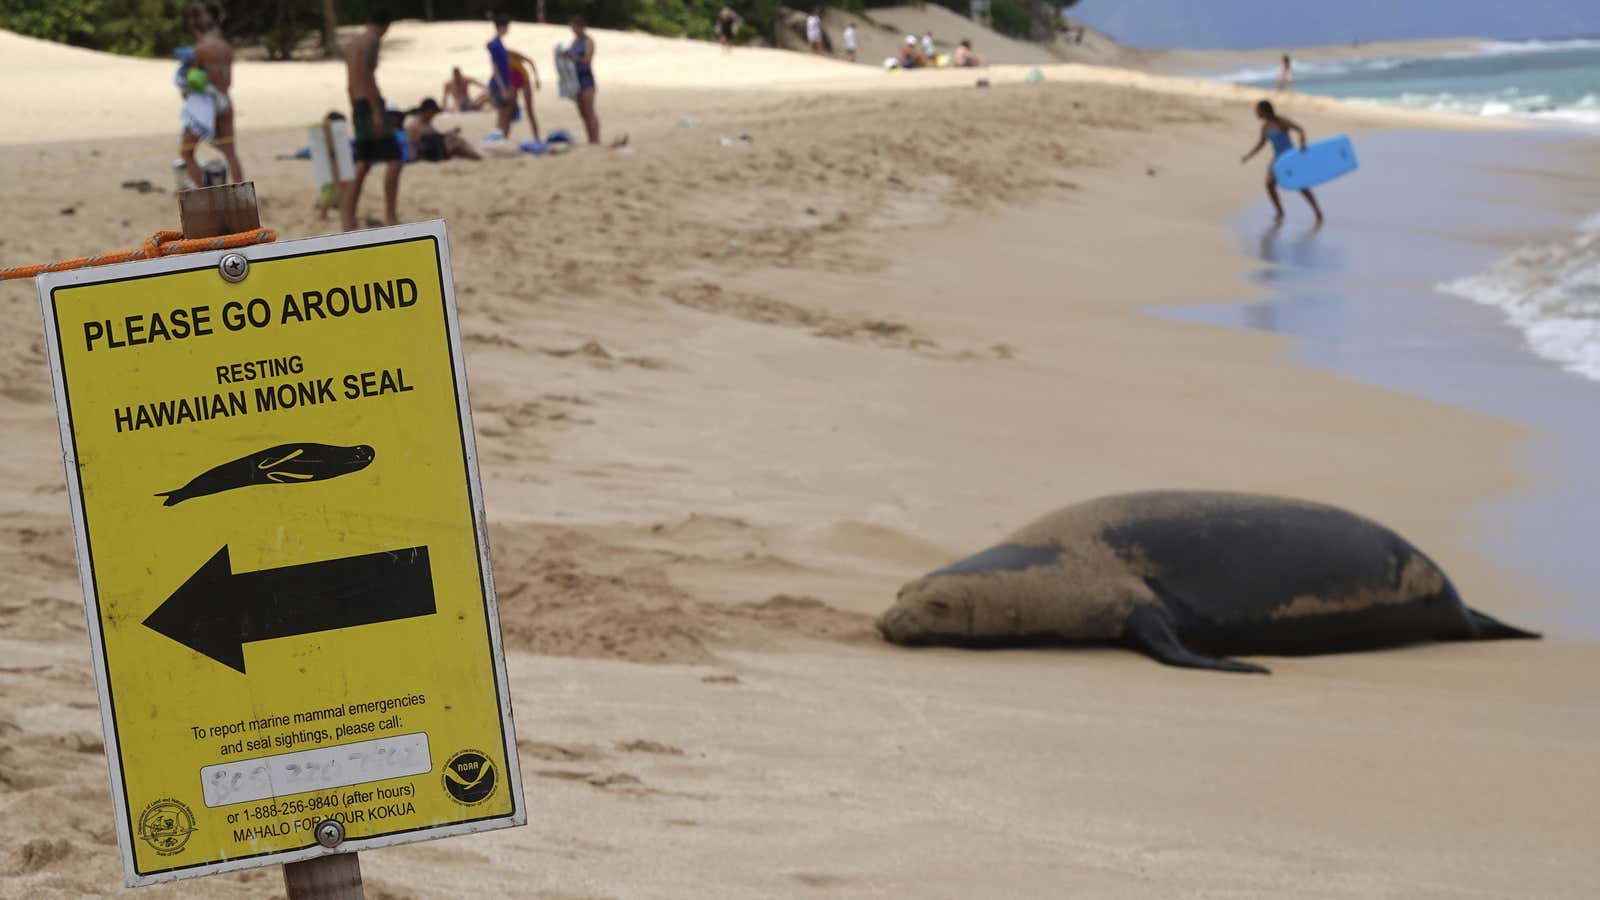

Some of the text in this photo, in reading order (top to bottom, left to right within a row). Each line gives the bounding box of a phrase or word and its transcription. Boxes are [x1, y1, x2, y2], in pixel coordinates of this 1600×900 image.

[83, 277, 419, 351] PLEASE GO AROUND
[215, 355, 304, 385] RESTING
[113, 367, 414, 433] HAWAIIAN MONK SEAL
[190, 694, 426, 741] To report marine mammal emergencies
[220, 714, 403, 757] and seal sightings, please call:
[457, 761, 479, 772] NOAA
[226, 783, 416, 826] or 1-888-256-9840 (after hours)
[233, 821, 291, 845] MAHALO
[294, 815, 321, 833] FOR
[367, 801, 416, 821] KOKUA
